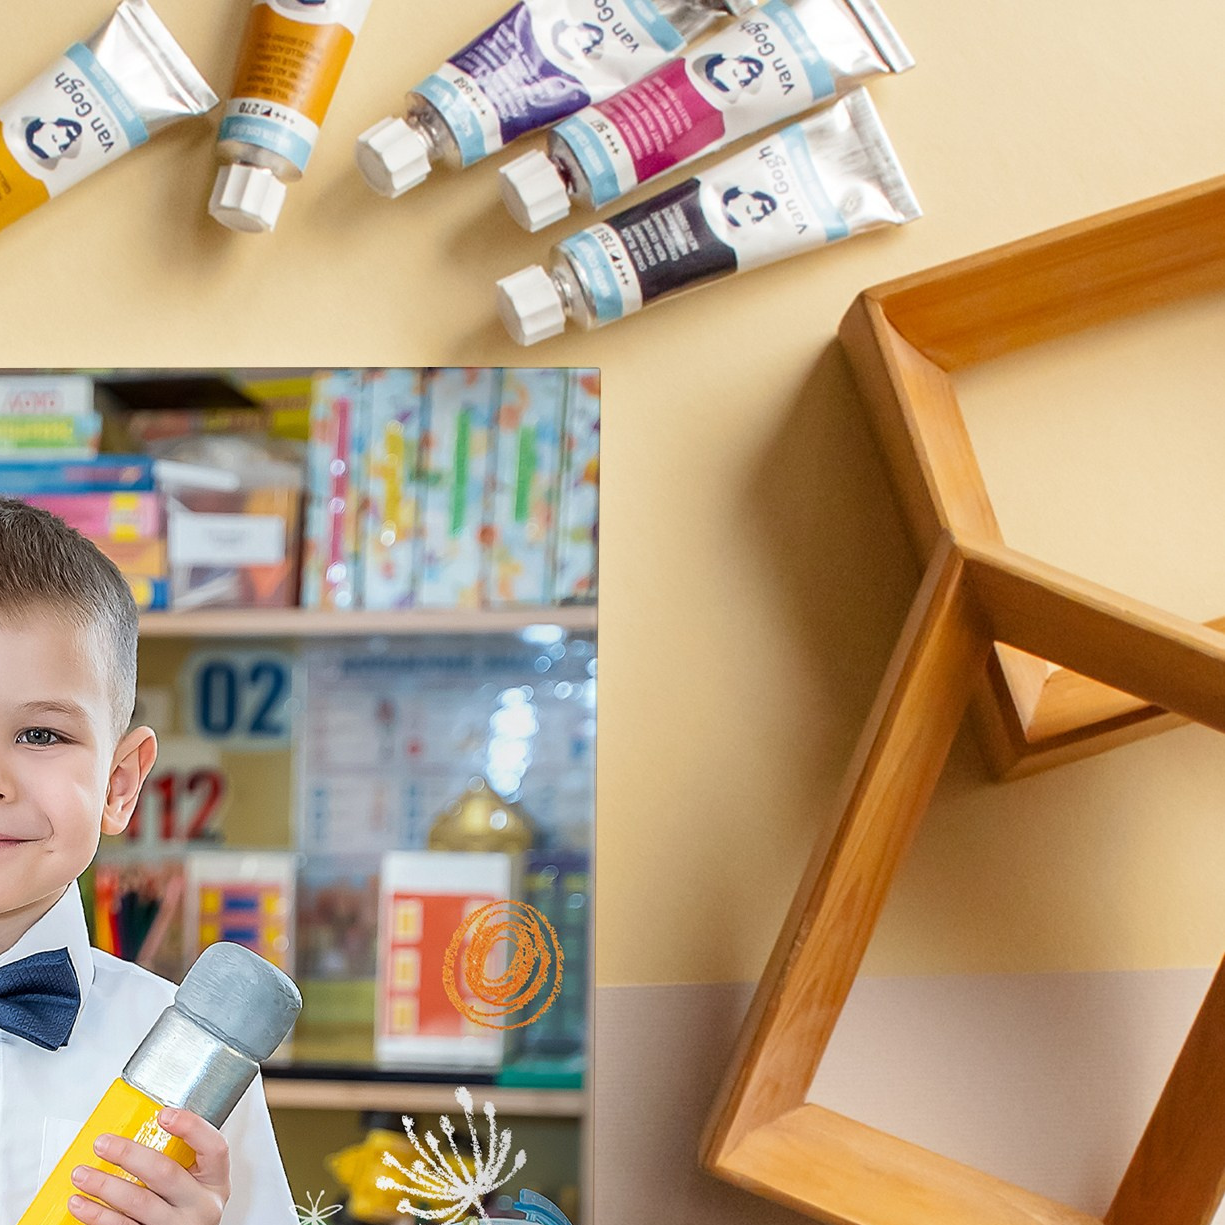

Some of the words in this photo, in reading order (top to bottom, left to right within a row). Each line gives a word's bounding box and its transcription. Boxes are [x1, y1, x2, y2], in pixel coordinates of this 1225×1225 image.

[611, 21, 640, 54] van
[739, 19, 775, 57] Gogh
[56, 72, 94, 118] Gogh
[771, 57, 795, 96] van
[239, 102, 259, 114] 270
[89, 117, 115, 153] van
[758, 144, 789, 196] Gogh
[780, 198, 807, 236] van
[197, 659, 291, 738] 02
